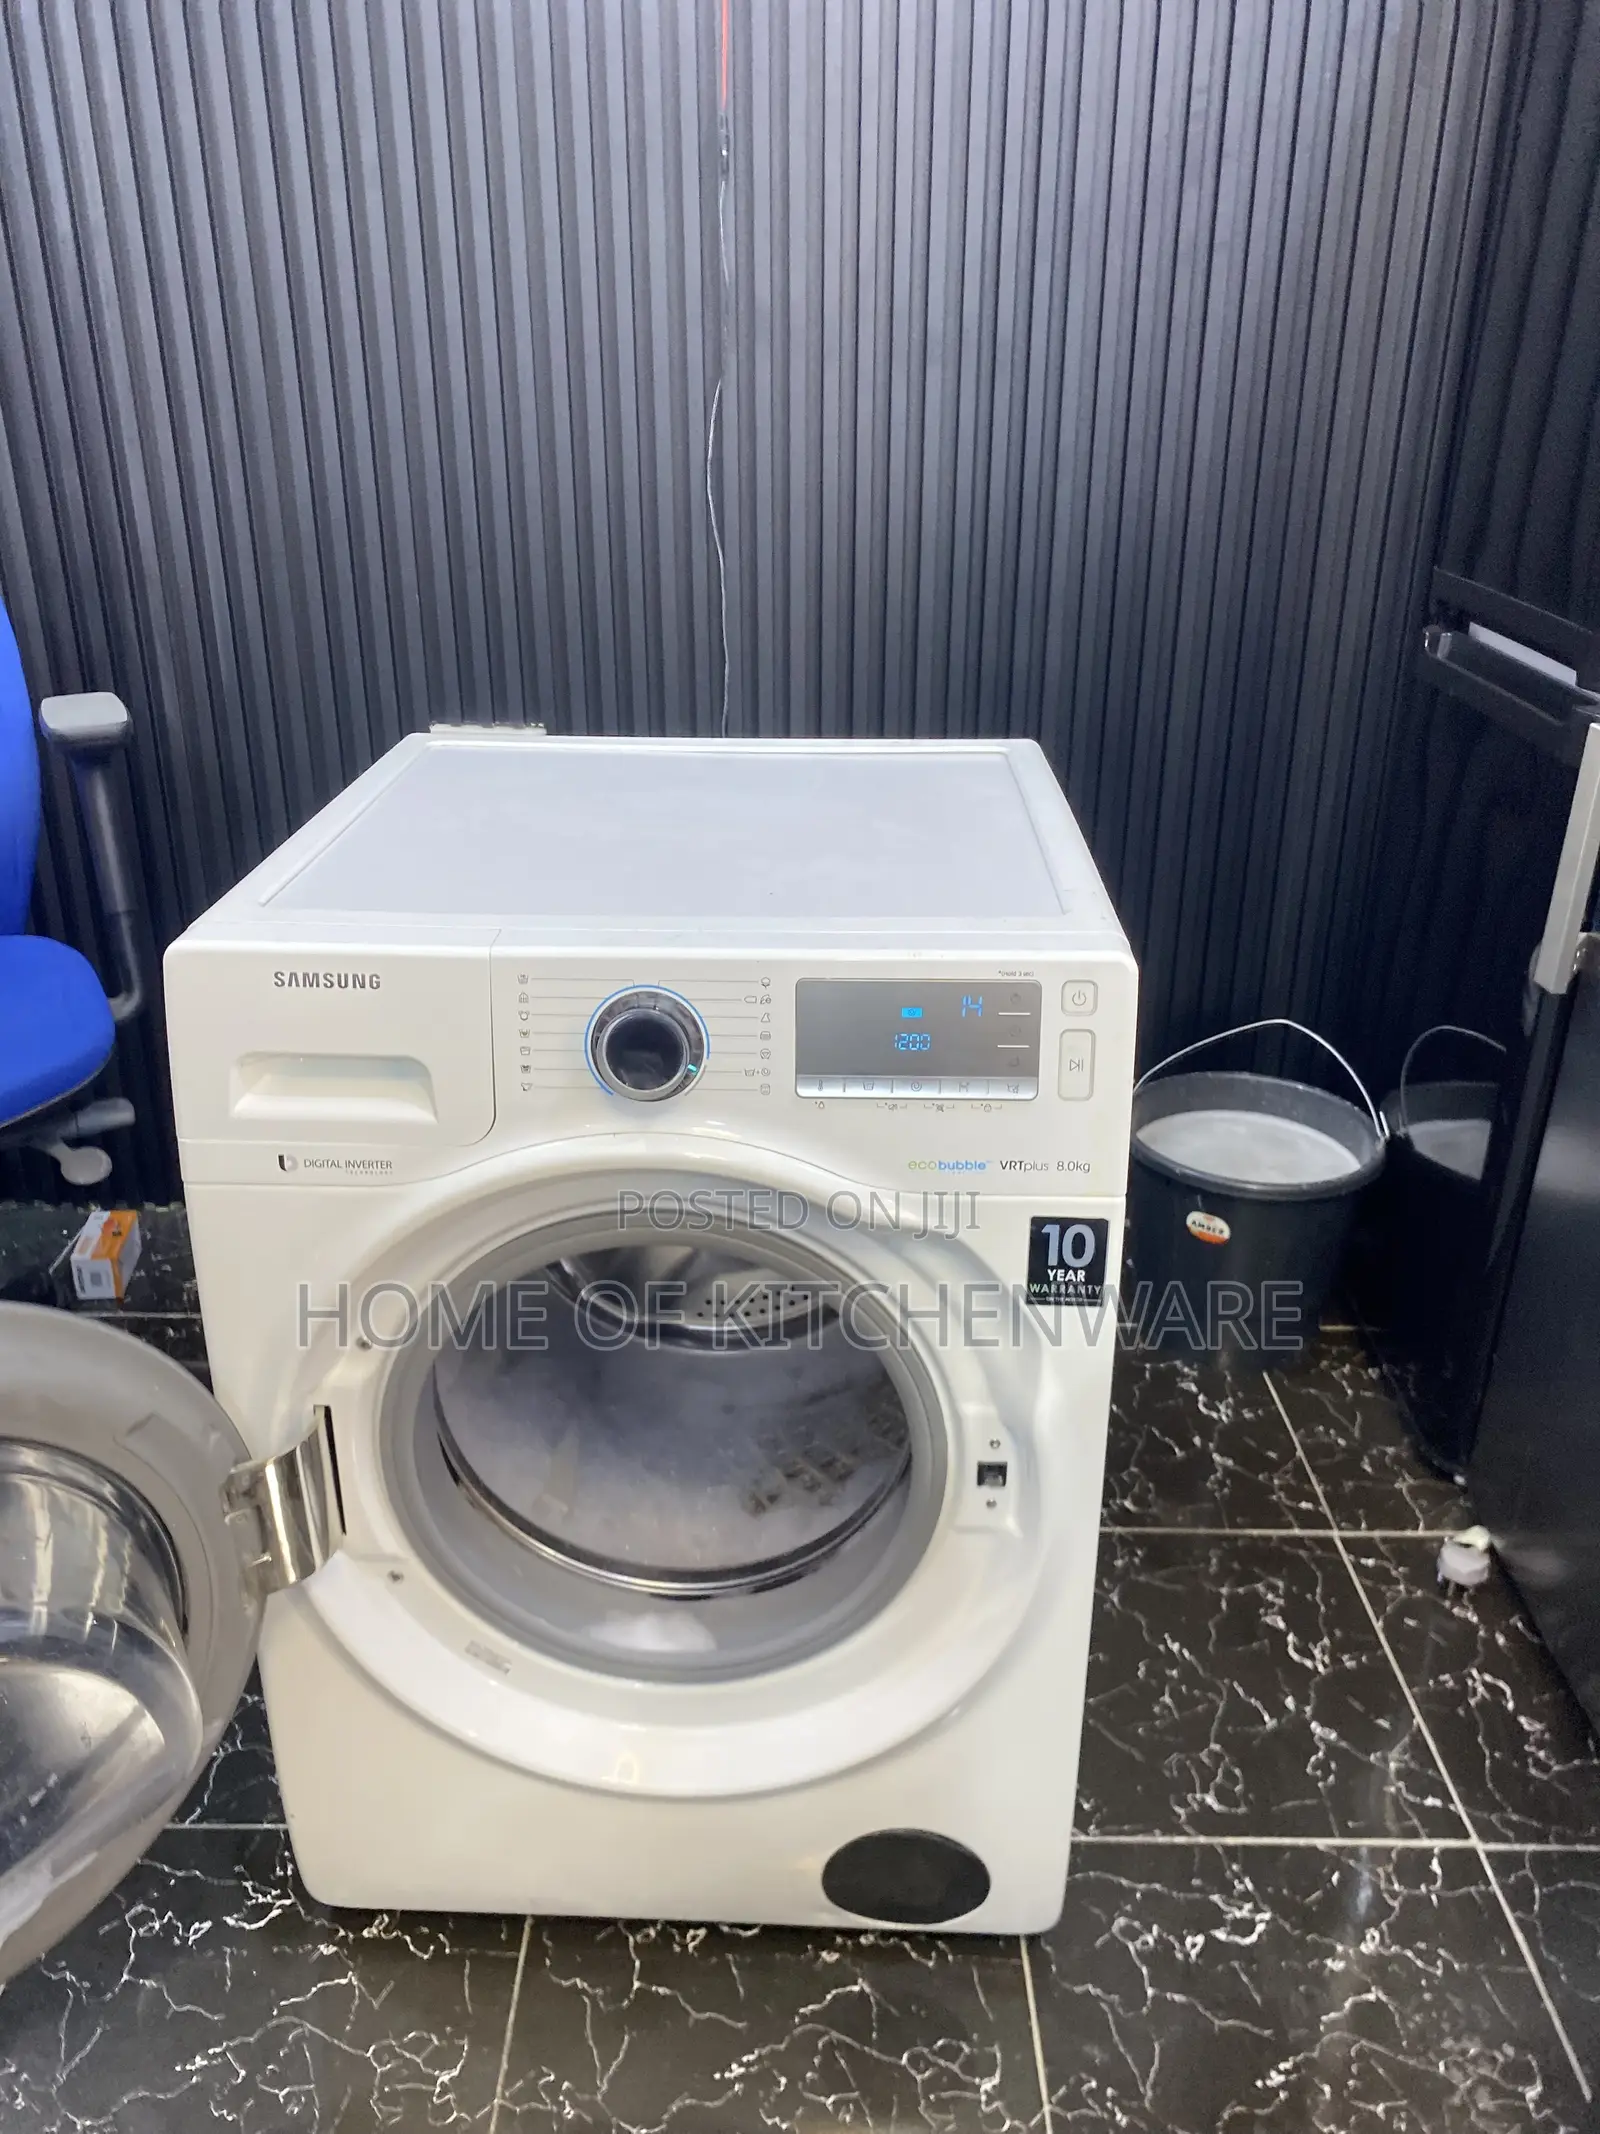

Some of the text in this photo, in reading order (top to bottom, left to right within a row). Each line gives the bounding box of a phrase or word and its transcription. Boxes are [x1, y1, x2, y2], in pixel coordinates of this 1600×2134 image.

[273, 971, 381, 990] SAMSUNG
[961, 994, 983, 1018] 14
[894, 1033, 931, 1051] 1200
[303, 1158, 393, 1170] DIGITAL INVERTER
[999, 1160, 1049, 1173] VRTplus
[1056, 1160, 1091, 1174] 8.0kg
[1041, 1223, 1096, 1268] 10
[1047, 1268, 1086, 1282] YEAR
[1029, 1283, 1102, 1295] WARRANTY
